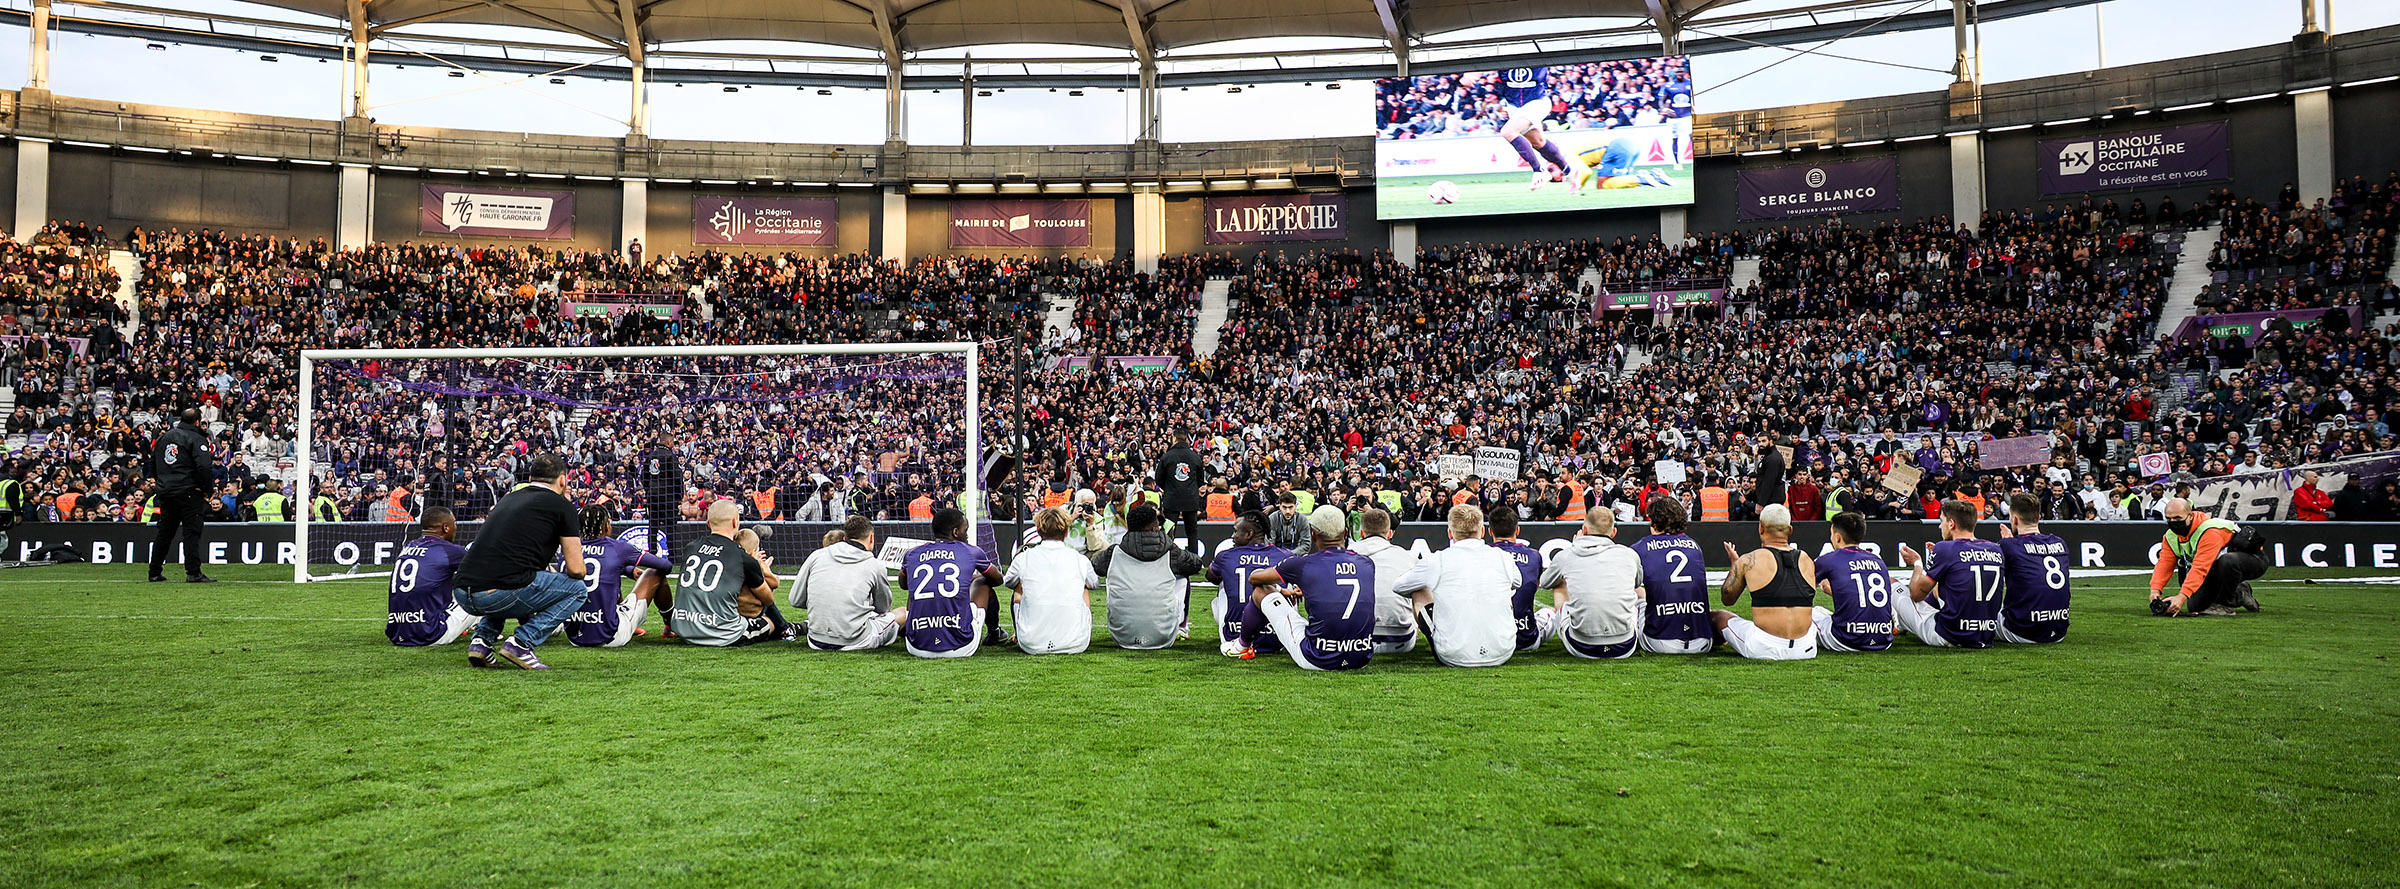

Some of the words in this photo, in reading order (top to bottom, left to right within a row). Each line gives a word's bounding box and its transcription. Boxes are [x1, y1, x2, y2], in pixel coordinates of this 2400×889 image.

[2098, 134, 2162, 150] BANQUE
[2099, 143, 2185, 161] POPULAIRE
[2099, 159, 2159, 172] OCCITANE
[2100, 178, 2108, 186] la
[2111, 174, 2148, 184] réussite
[2151, 172, 2166, 181] est
[2184, 169, 2208, 177] vous
[1760, 193, 1807, 206] SERGE
[1814, 187, 1876, 202] BLANCO
[451, 194, 473, 225] HG
[1215, 208, 1242, 232] LA
[1243, 203, 1338, 231] DÉPÊCHE
[755, 216, 822, 228] Occitanie
[955, 219, 989, 227] MAIRIE
[992, 219, 1005, 227] DE
[1034, 219, 1085, 227] TOULOUSE
[1618, 295, 1648, 303] SORTIE
[1656, 294, 1669, 311] 8
[580, 545, 605, 555] MOU
[698, 544, 724, 557] DUPÉ
[1240, 554, 1270, 566] SYLLA
[1335, 562, 1357, 575] ADO
[1665, 549, 1693, 583] 2
[1848, 559, 1882, 571] SANNA
[391, 558, 419, 593] 19
[680, 554, 724, 592] 30
[913, 562, 960, 600] 23
[2043, 555, 2066, 590] 8
[1850, 572, 1889, 608] 18
[1969, 565, 2001, 602] 17
[1336, 578, 1361, 620] 7
